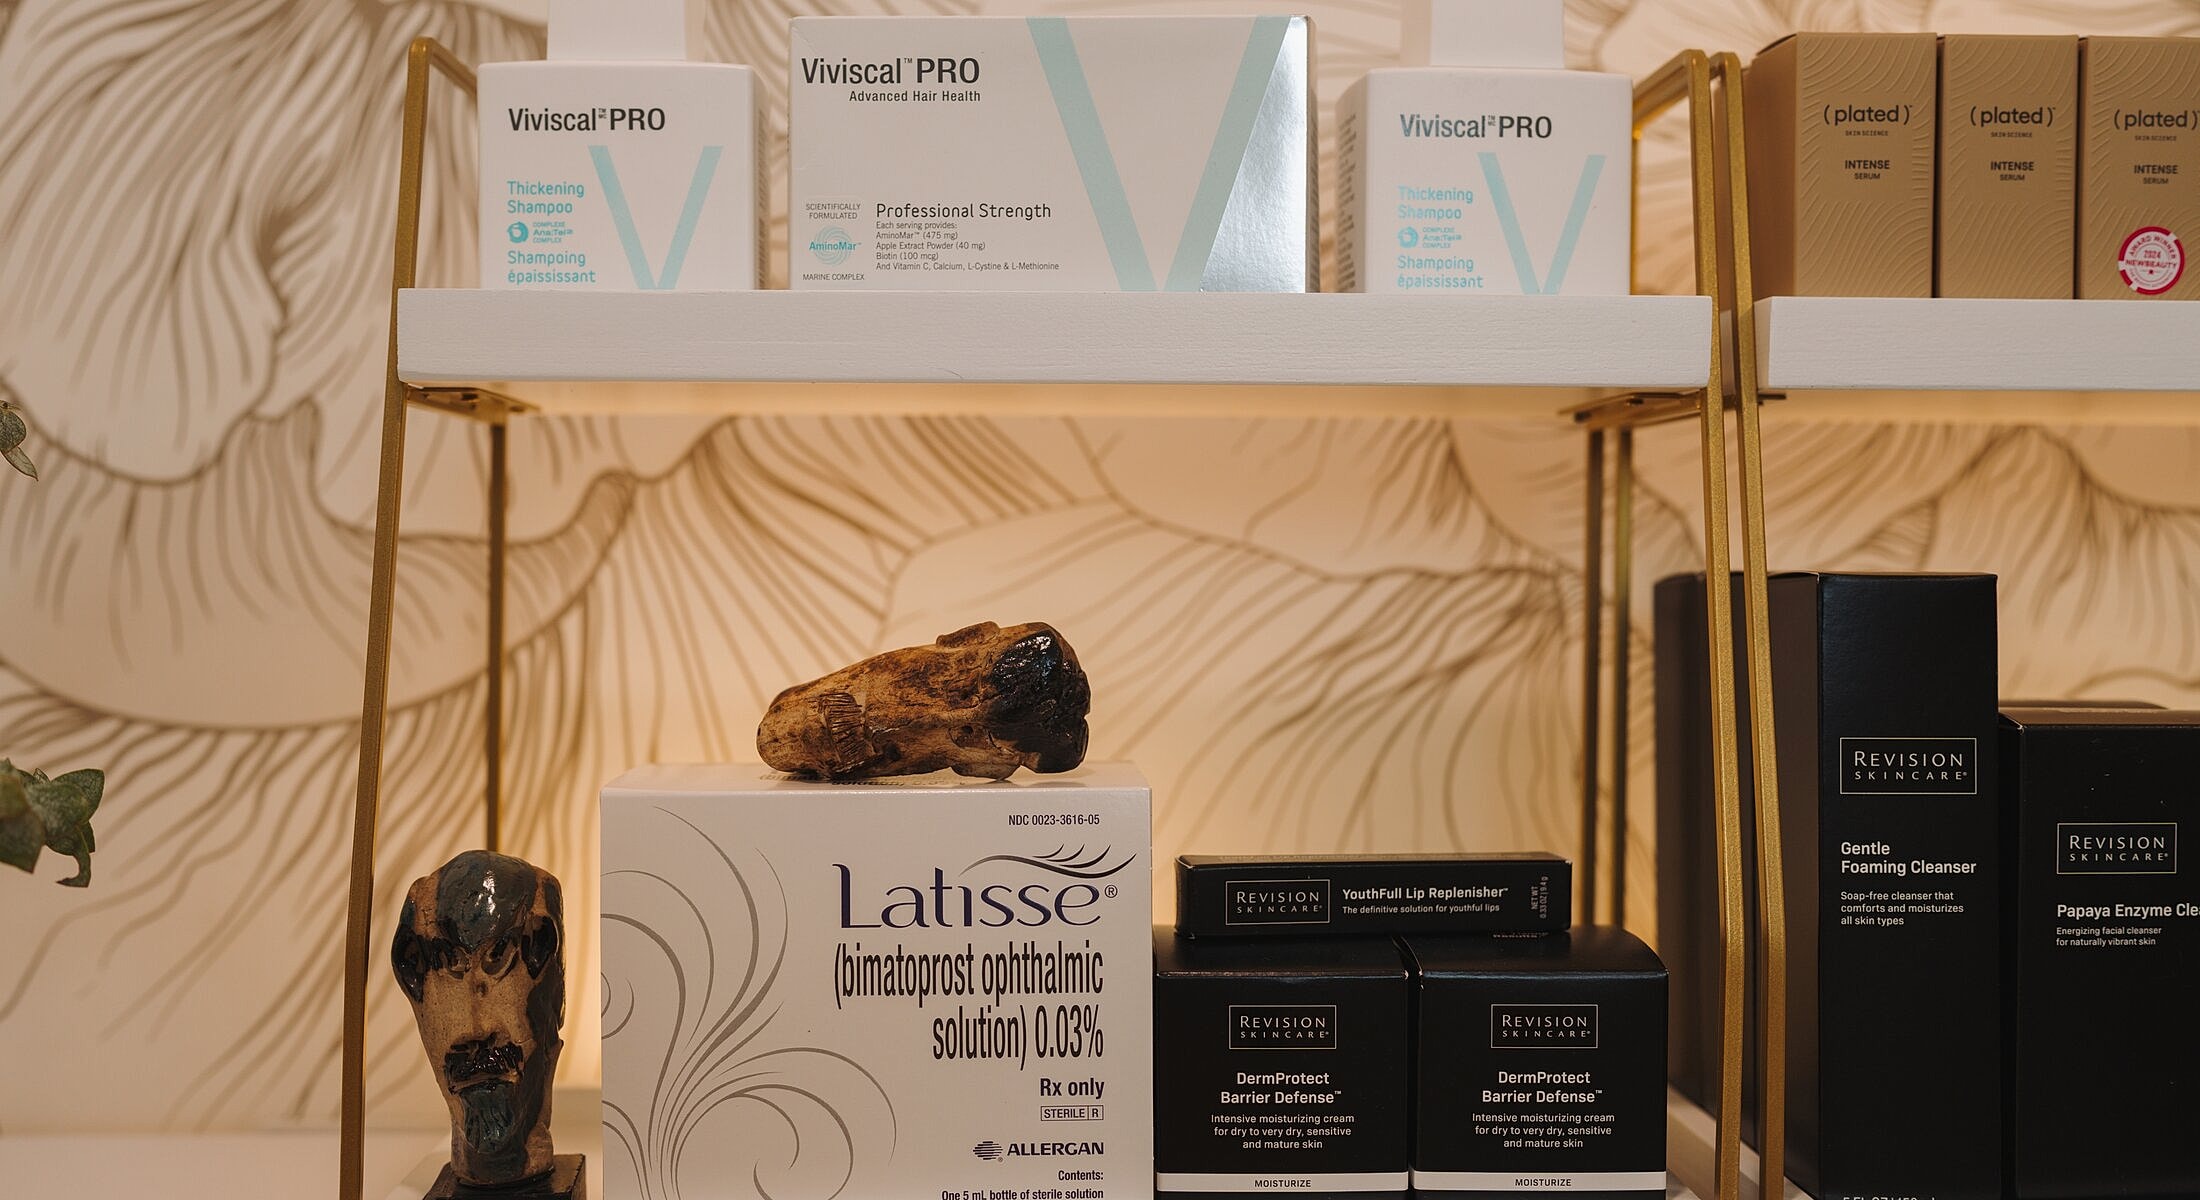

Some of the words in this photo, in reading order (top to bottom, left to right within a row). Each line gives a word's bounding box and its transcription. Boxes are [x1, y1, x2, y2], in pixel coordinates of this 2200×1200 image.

[916, 58, 980, 84] PRO
[849, 91, 908, 102] Advanced
[913, 91, 937, 102] Hair
[942, 91, 981, 102] Health
[610, 108, 666, 131] PRO
[1499, 116, 1552, 138] PRO
[1845, 160, 1890, 170] INTENSE
[1990, 161, 2035, 171] INTENSE
[2134, 164, 2178, 175] INTENSE
[1854, 172, 1881, 180] SERUM
[507, 181, 585, 198] Thickening
[1397, 186, 1473, 204] Thickening
[507, 200, 573, 216] Shampoo
[805, 203, 861, 211] SCIENTIFICALLY
[876, 203, 974, 218] Professional
[979, 204, 1051, 220] Strength
[1398, 204, 1462, 221] Shampoo
[809, 212, 858, 220] FORMULATED
[876, 222, 894, 230] Each
[896, 222, 922, 231] serving
[925, 222, 958, 231] provides:
[922, 231, 942, 240] (475
[944, 232, 959, 240] mg)
[875, 242, 897, 250] Apple
[899, 242, 925, 250] Extract
[926, 242, 954, 250] Powder
[955, 242, 969, 250] (40
[971, 242, 986, 251] mg)
[2129, 235, 2152, 256] AWARD
[507, 250, 586, 267] Shampoing
[876, 252, 898, 260] Biotin
[900, 252, 919, 261] (100
[920, 252, 939, 261] mcg)
[875, 263, 891, 271] And
[892, 263, 921, 271] Vitamin
[923, 263, 931, 271] C,
[933, 263, 965, 271] Calcium,
[968, 263, 1002, 271] L-Cystine
[1011, 263, 1060, 271] L-Methionine
[1398, 255, 1474, 272] Shampoing
[2125, 259, 2178, 269] NEWBEAUTY
[507, 268, 596, 285] épaississant
[802, 273, 830, 281] MARINE
[832, 273, 865, 281] COMPLEX
[1397, 274, 1484, 290] épaississant
[1854, 751, 1963, 767] REVISION
[1008, 814, 1030, 826] NDC
[1031, 814, 1100, 826] 0023-3616-05
[1841, 841, 1890, 855] Gentle
[2069, 835, 2165, 850] REVISION
[1841, 860, 1907, 876] Foaming
[1910, 860, 1977, 874] Cleanser
[1236, 890, 1320, 903] REVISION
[1342, 887, 1402, 900] YouthFull
[1405, 887, 1425, 902] Lip
[1531, 886, 1538, 896] WT
[1840, 891, 1889, 902] Soap-free
[1891, 891, 1932, 901] cleanser
[1934, 891, 1954, 901] that
[1342, 905, 1357, 914] The
[1359, 905, 1398, 914] definitive
[1400, 905, 1434, 914] solution
[1435, 904, 1448, 913] for
[1449, 903, 1484, 915] youthful
[1484, 903, 1500, 913] lips
[1840, 903, 1886, 913] comforts
[1887, 903, 1906, 913] and
[1908, 903, 1964, 913] moisturizes
[2057, 904, 2111, 920] Papaya
[2115, 904, 2172, 920] Enzyme
[2176, 903, 2200, 917] Cle
[1840, 916, 1853, 925] all
[1854, 916, 1875, 925] skin
[1877, 916, 1905, 927] types
[2056, 927, 2100, 936] Energizing
[2102, 926, 2125, 935] facial
[2126, 926, 2162, 935] cleanser
[2056, 938, 2068, 946] for
[2070, 937, 2107, 947] naturally
[2108, 937, 2137, 946] vibrant
[2138, 937, 2156, 946] skin
[834, 943, 974, 1010] (bimatoprost
[981, 940, 1104, 1008] ophthalmic
[1240, 1015, 1326, 1028] REVISION
[1502, 1014, 1587, 1028] REVISION
[932, 1005, 1027, 1071] solution)
[1035, 1004, 1104, 1058] 0.03%
[1237, 1072, 1330, 1085] DermProtect
[1498, 1071, 1591, 1084] DermProtect
[1040, 1078, 1062, 1096] Rx
[1067, 1078, 1105, 1100] only
[1220, 1091, 1271, 1104] Barrier
[1482, 1090, 1532, 1103] Barrier
[1044, 1108, 1086, 1118] STERILE
[1472, 1113, 1518, 1123] Intensive
[1520, 1113, 1582, 1124] moisturizing
[1584, 1115, 1615, 1123] cream
[1211, 1114, 1257, 1124] Intensive
[1259, 1114, 1321, 1125] moisturizing
[1323, 1116, 1355, 1124] cream
[1214, 1127, 1228, 1136] for
[1230, 1127, 1247, 1138] dry
[1249, 1128, 1260, 1136] to
[1262, 1128, 1283, 1138] very
[1285, 1127, 1305, 1138] dry,
[1306, 1127, 1352, 1136] sensitive
[1475, 1126, 1489, 1135] for
[1491, 1126, 1508, 1137] dry
[1510, 1127, 1521, 1135] to
[1523, 1127, 1544, 1137] very
[1546, 1126, 1565, 1137] dry,
[1567, 1126, 1612, 1135] sensitive
[1006, 1142, 1104, 1156] ALLERGAN
[1242, 1139, 1262, 1149] and
[1264, 1141, 1300, 1149] mature
[1302, 1139, 1323, 1149] skin
[1503, 1138, 1522, 1148] and
[1525, 1140, 1561, 1148] mature
[1563, 1138, 1584, 1148] skin
[1058, 1170, 1104, 1181] Contents:
[1254, 1179, 1312, 1188] MOISTURIZE
[1515, 1178, 1572, 1187] MOISTURIZE
[941, 1190, 960, 1200] One
[963, 1190, 969, 1200] 5
[972, 1190, 987, 1200] mL
[990, 1190, 1017, 1200] bottle
[1020, 1189, 1030, 1200] of
[1032, 1189, 1062, 1200] sterile
[1065, 1188, 1104, 1199] solution
